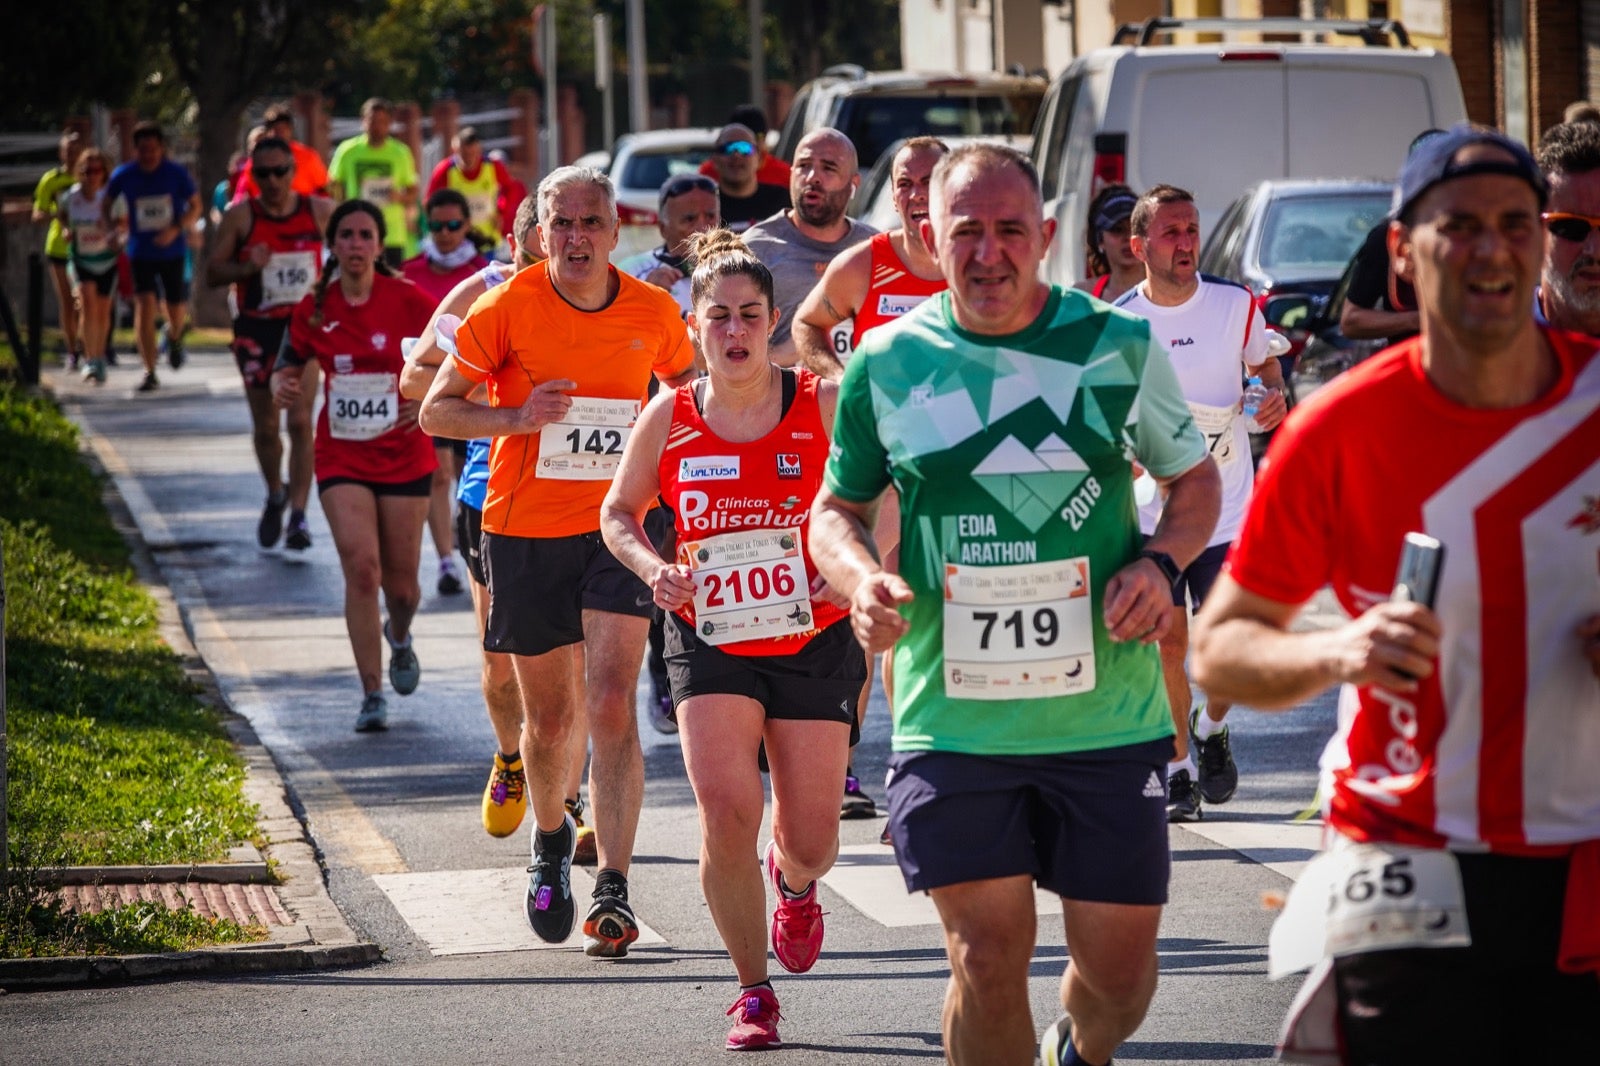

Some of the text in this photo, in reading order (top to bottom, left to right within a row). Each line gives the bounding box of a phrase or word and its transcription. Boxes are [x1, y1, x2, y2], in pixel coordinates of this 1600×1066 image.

[834, 330, 855, 354] 6
[1171, 336, 1194, 348] FILA
[335, 398, 389, 419] 3044
[566, 428, 624, 455] 142
[778, 455, 785, 467] I
[778, 466, 801, 475] MOVE
[679, 490, 810, 531] Polisalud
[715, 497, 771, 510] Clínicas
[1061, 476, 1102, 531] 2018
[703, 563, 796, 608] 2106
[972, 607, 1060, 650] 719
